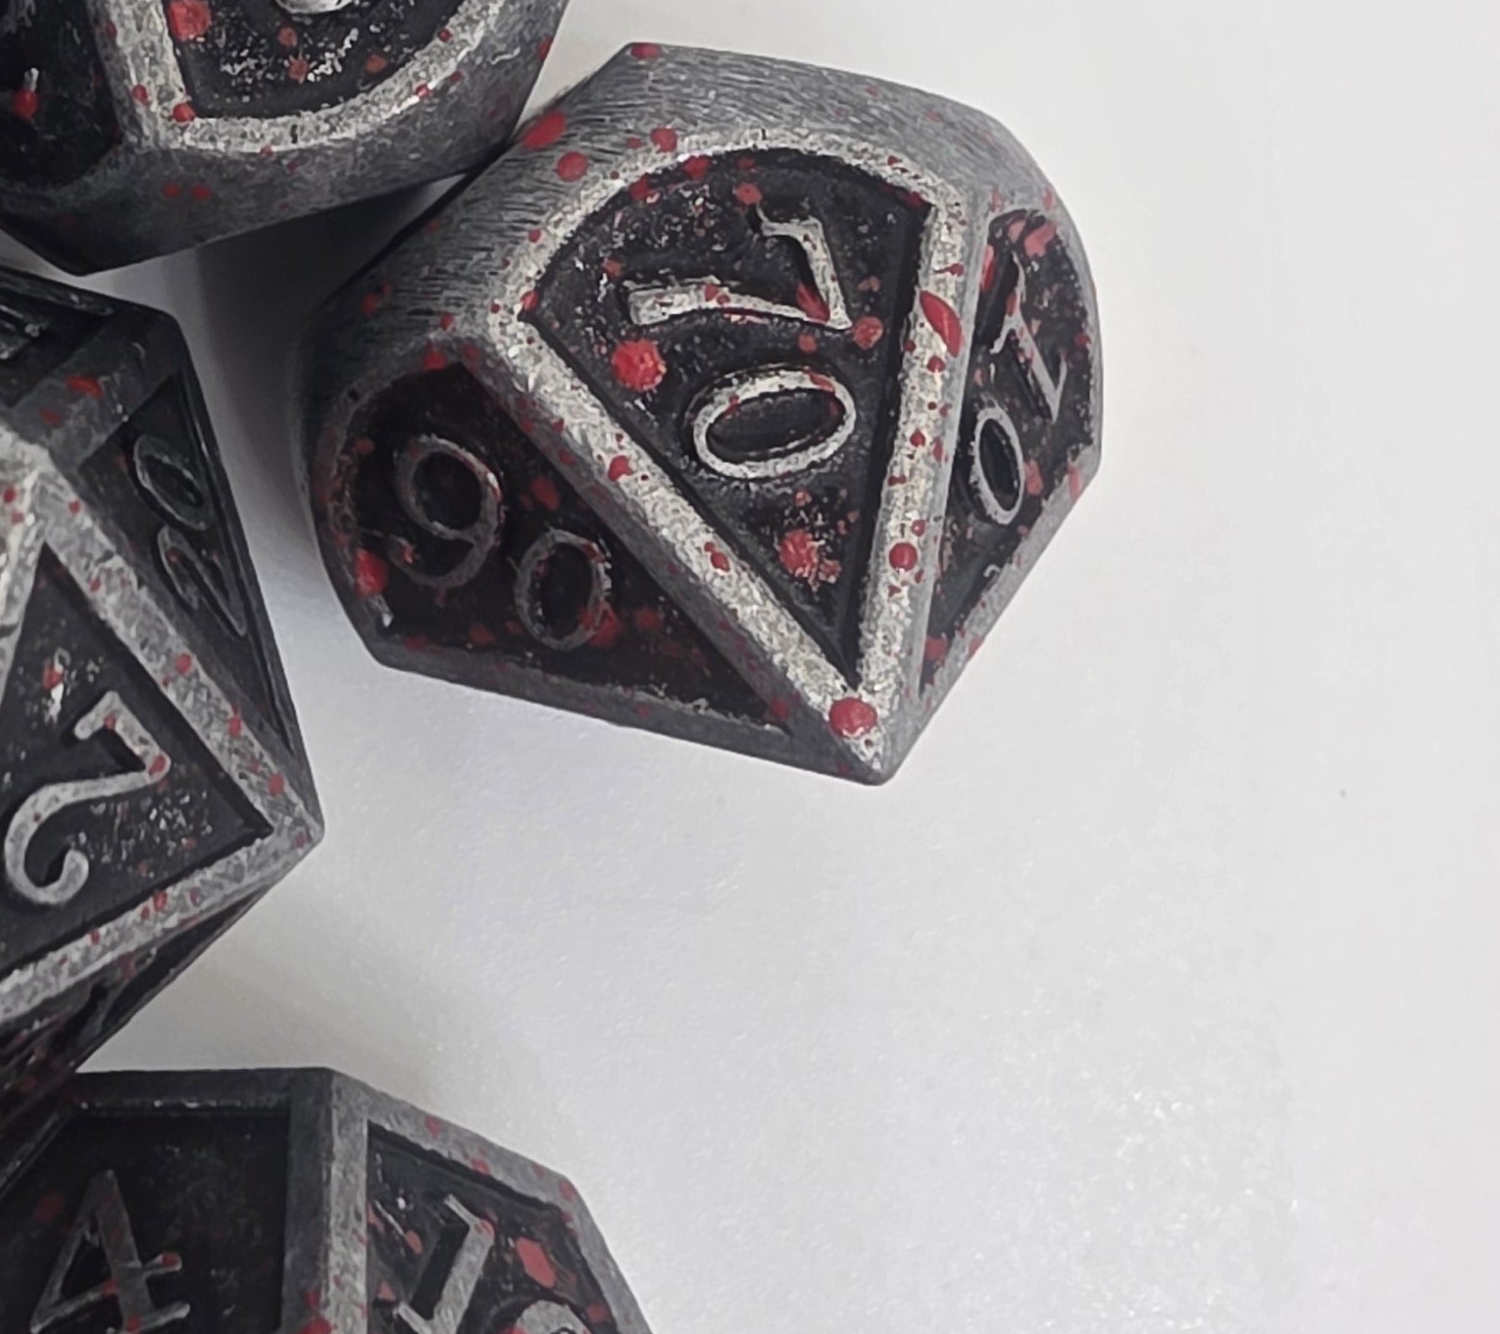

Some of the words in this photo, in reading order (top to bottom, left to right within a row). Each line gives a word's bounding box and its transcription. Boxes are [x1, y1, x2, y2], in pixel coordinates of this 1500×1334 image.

[627, 205, 857, 479] 70
[390, 433, 613, 649] 90
[4, 692, 171, 906] 2
